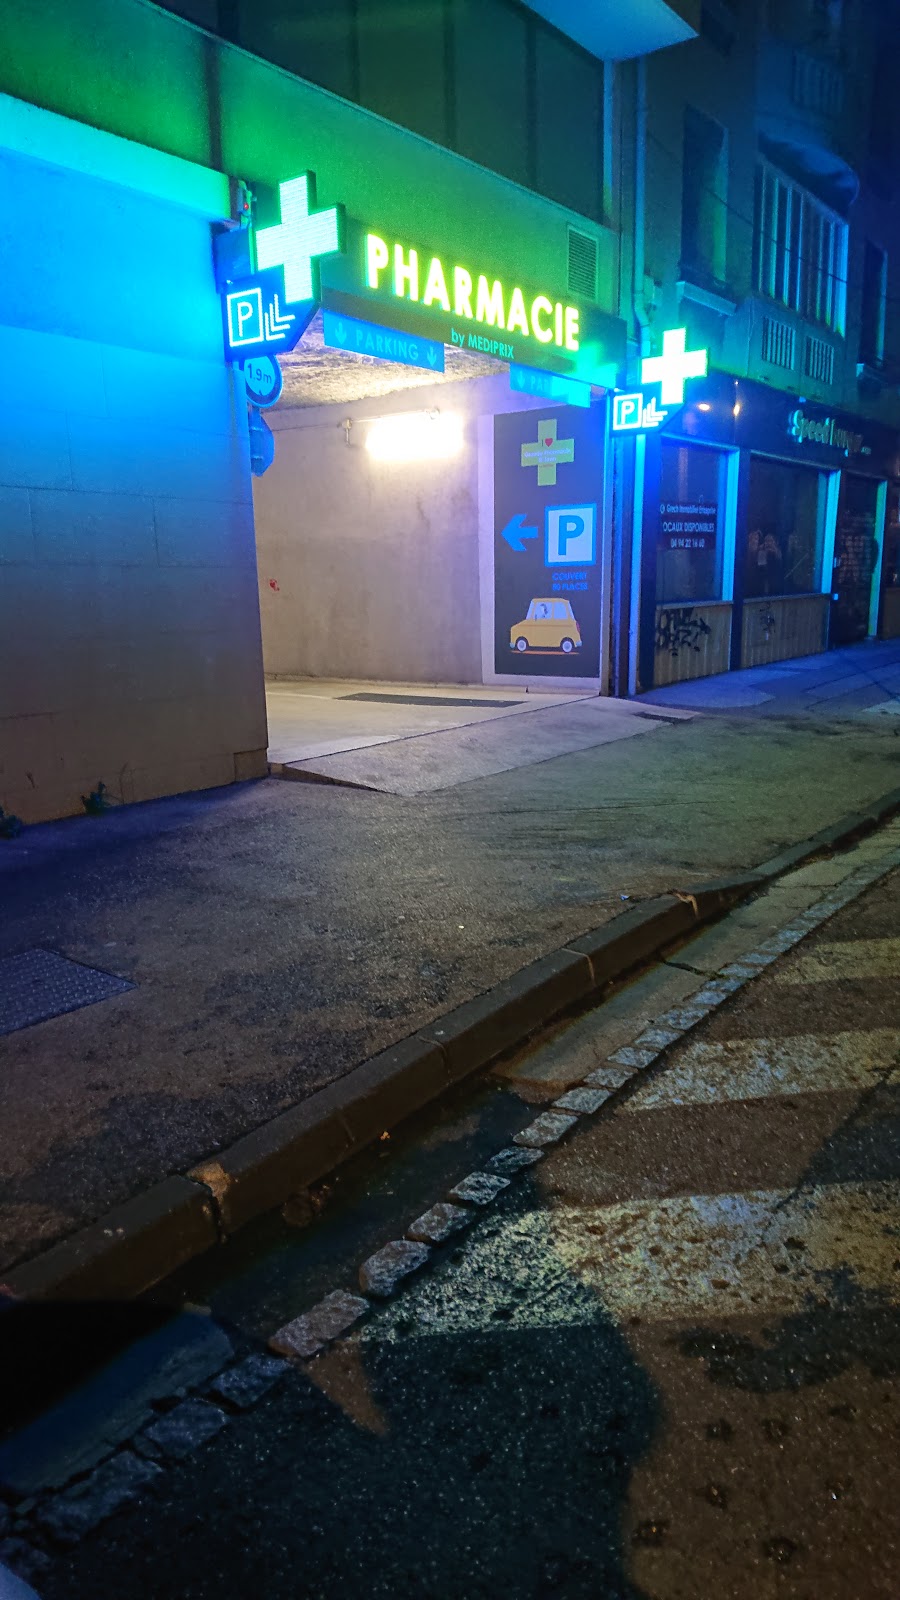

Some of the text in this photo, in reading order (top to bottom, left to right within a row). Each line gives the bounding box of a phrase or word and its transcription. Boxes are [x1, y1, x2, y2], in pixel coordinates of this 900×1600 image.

[365, 233, 580, 352] PHARMACIE
[236, 301, 254, 338] P
[355, 329, 419, 361] PARKING
[451, 327, 515, 360] by MEDIPRIX
[621, 401, 636, 425] P
[558, 514, 585, 556] P
[552, 571, 587, 580] COUVERT
